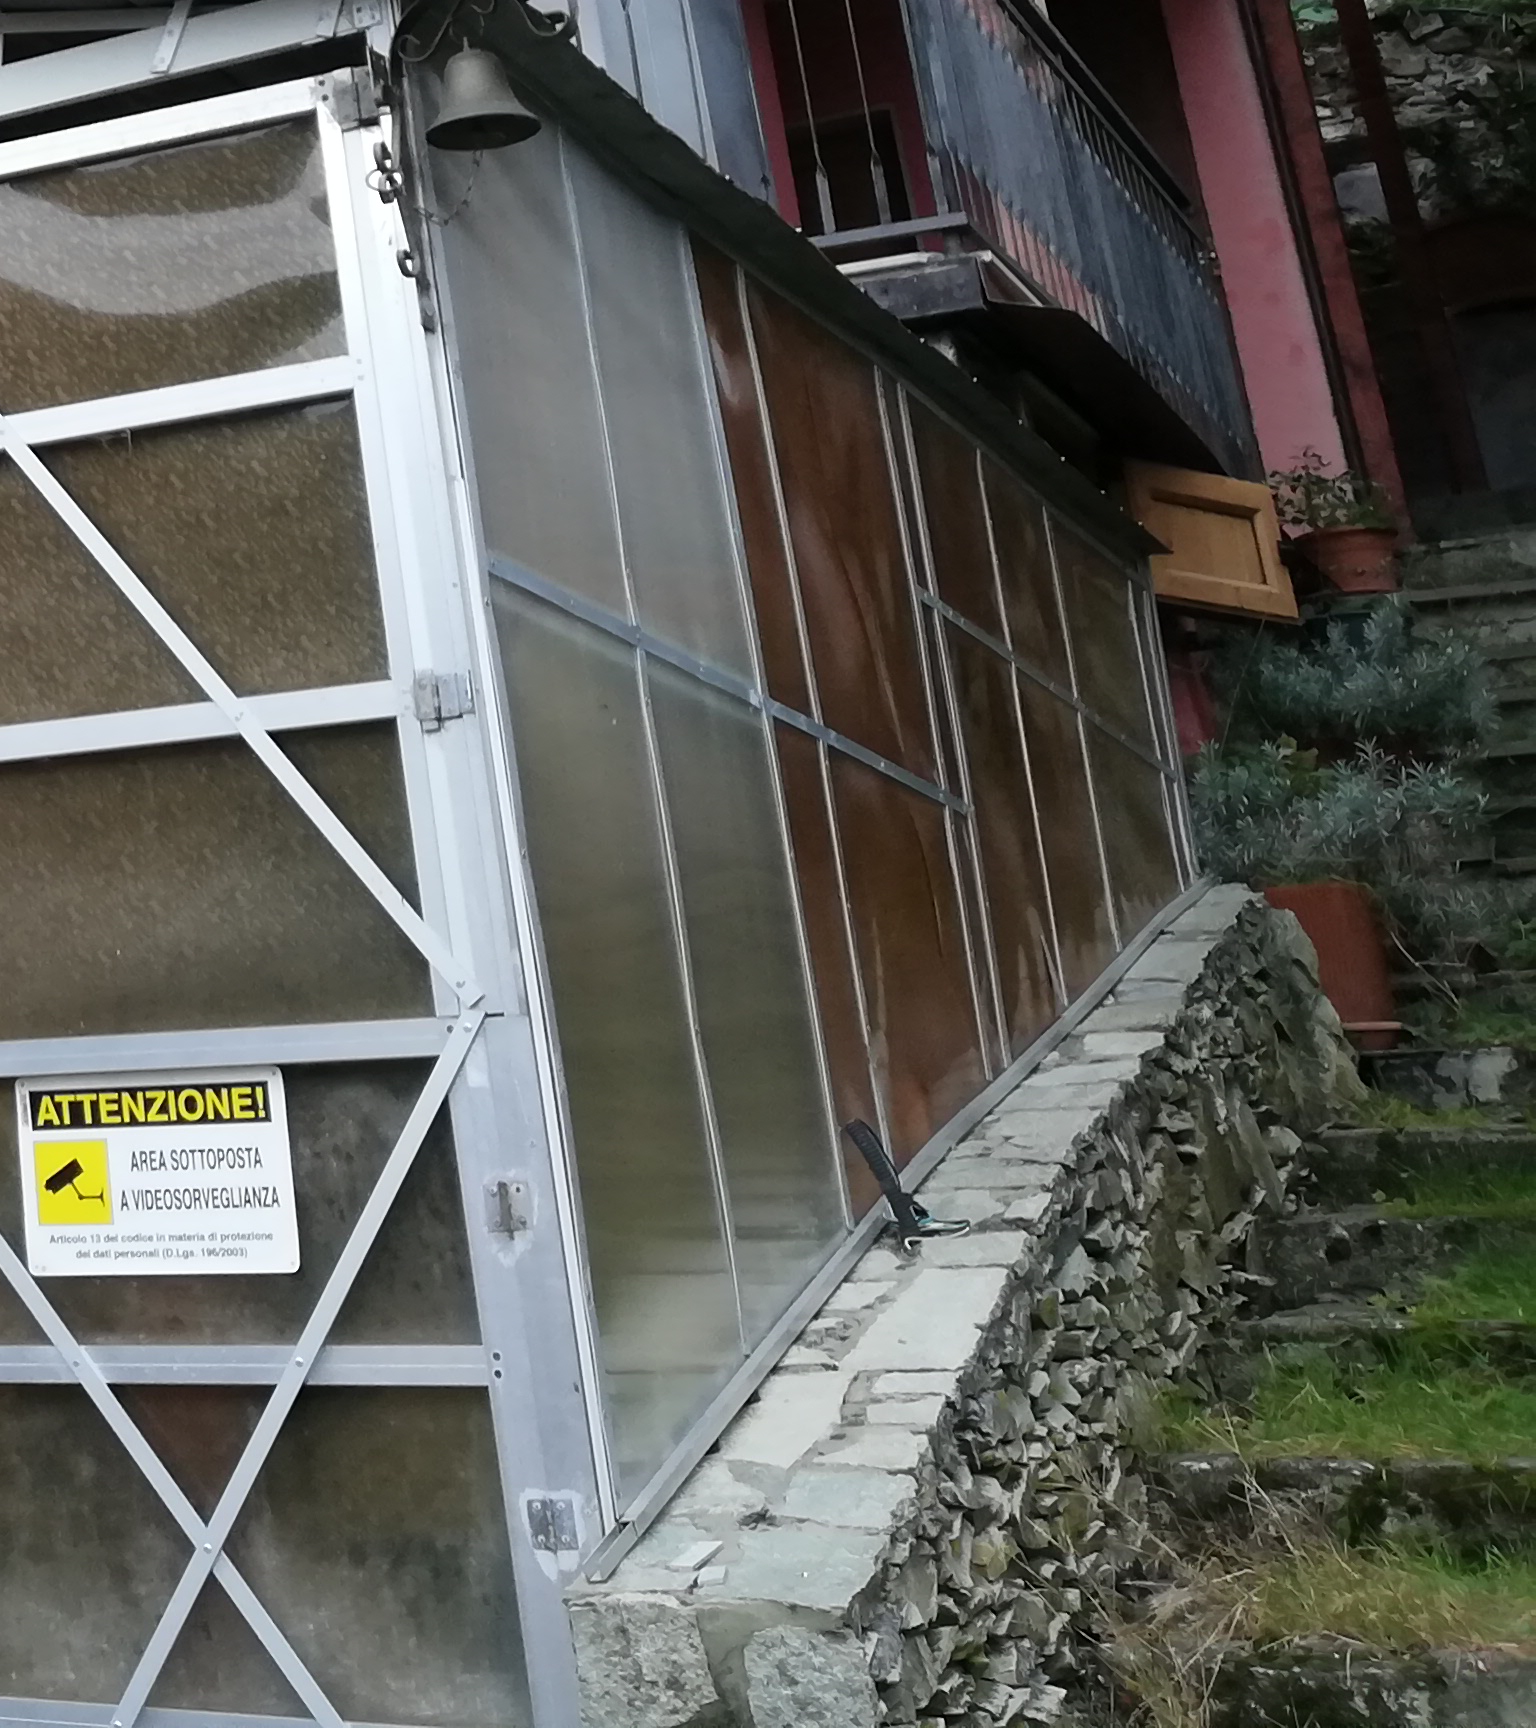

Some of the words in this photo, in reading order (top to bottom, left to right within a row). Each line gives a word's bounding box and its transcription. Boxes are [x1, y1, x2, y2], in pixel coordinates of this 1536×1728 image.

[37, 1086, 266, 1126] ATTENZIONE!
[131, 1149, 167, 1172] AREA
[170, 1147, 263, 1171] SOTTOPOSTA
[120, 1190, 130, 1211] A
[132, 1186, 280, 1211] VIDEOSORVEGLIANZA
[49, 1234, 87, 1244] Articolo
[90, 1234, 101, 1244] 13
[121, 1233, 154, 1243] codice
[156, 1233, 166, 1243] in
[168, 1233, 206, 1243] materia
[208, 1232, 218, 1242] di
[220, 1231, 274, 1243] protezione
[93, 1249, 112, 1259] dati
[114, 1248, 160, 1260] personali
